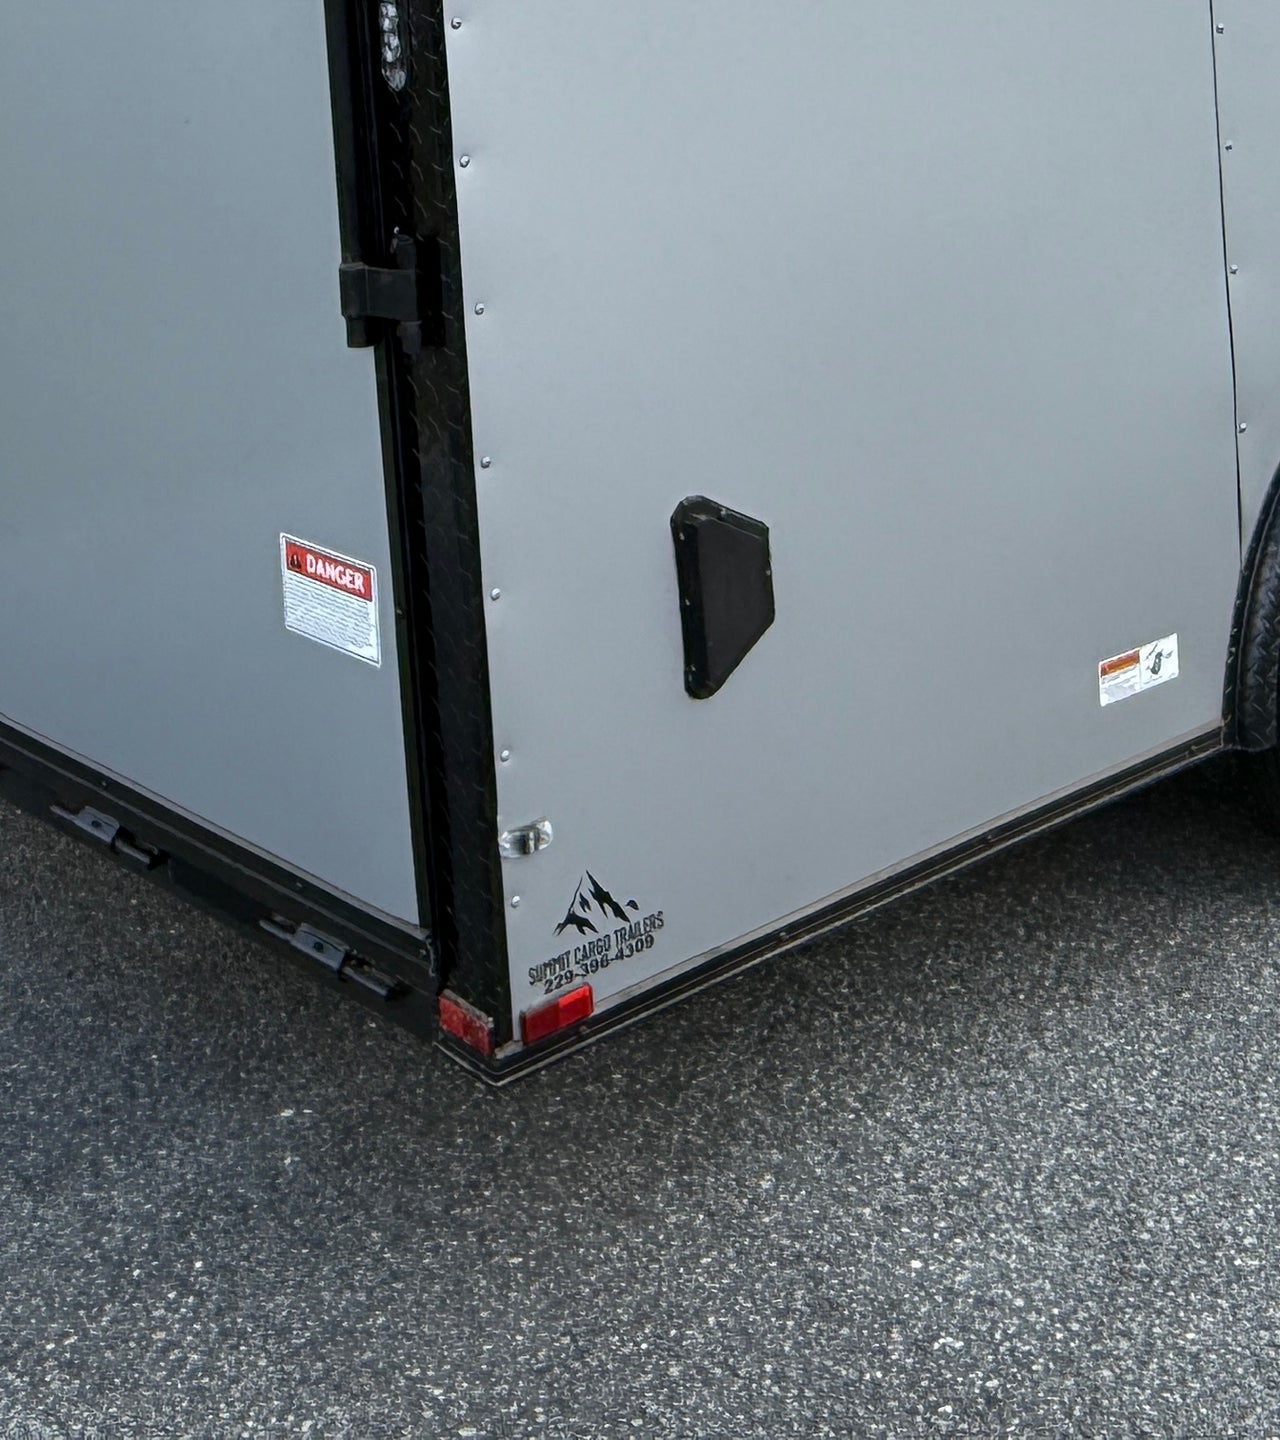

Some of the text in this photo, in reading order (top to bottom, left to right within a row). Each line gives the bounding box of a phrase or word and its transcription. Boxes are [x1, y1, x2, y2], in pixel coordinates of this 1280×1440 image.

[306, 553, 365, 594] DANGER
[528, 910, 664, 986] SUMMIT CARGO TRAILERS
